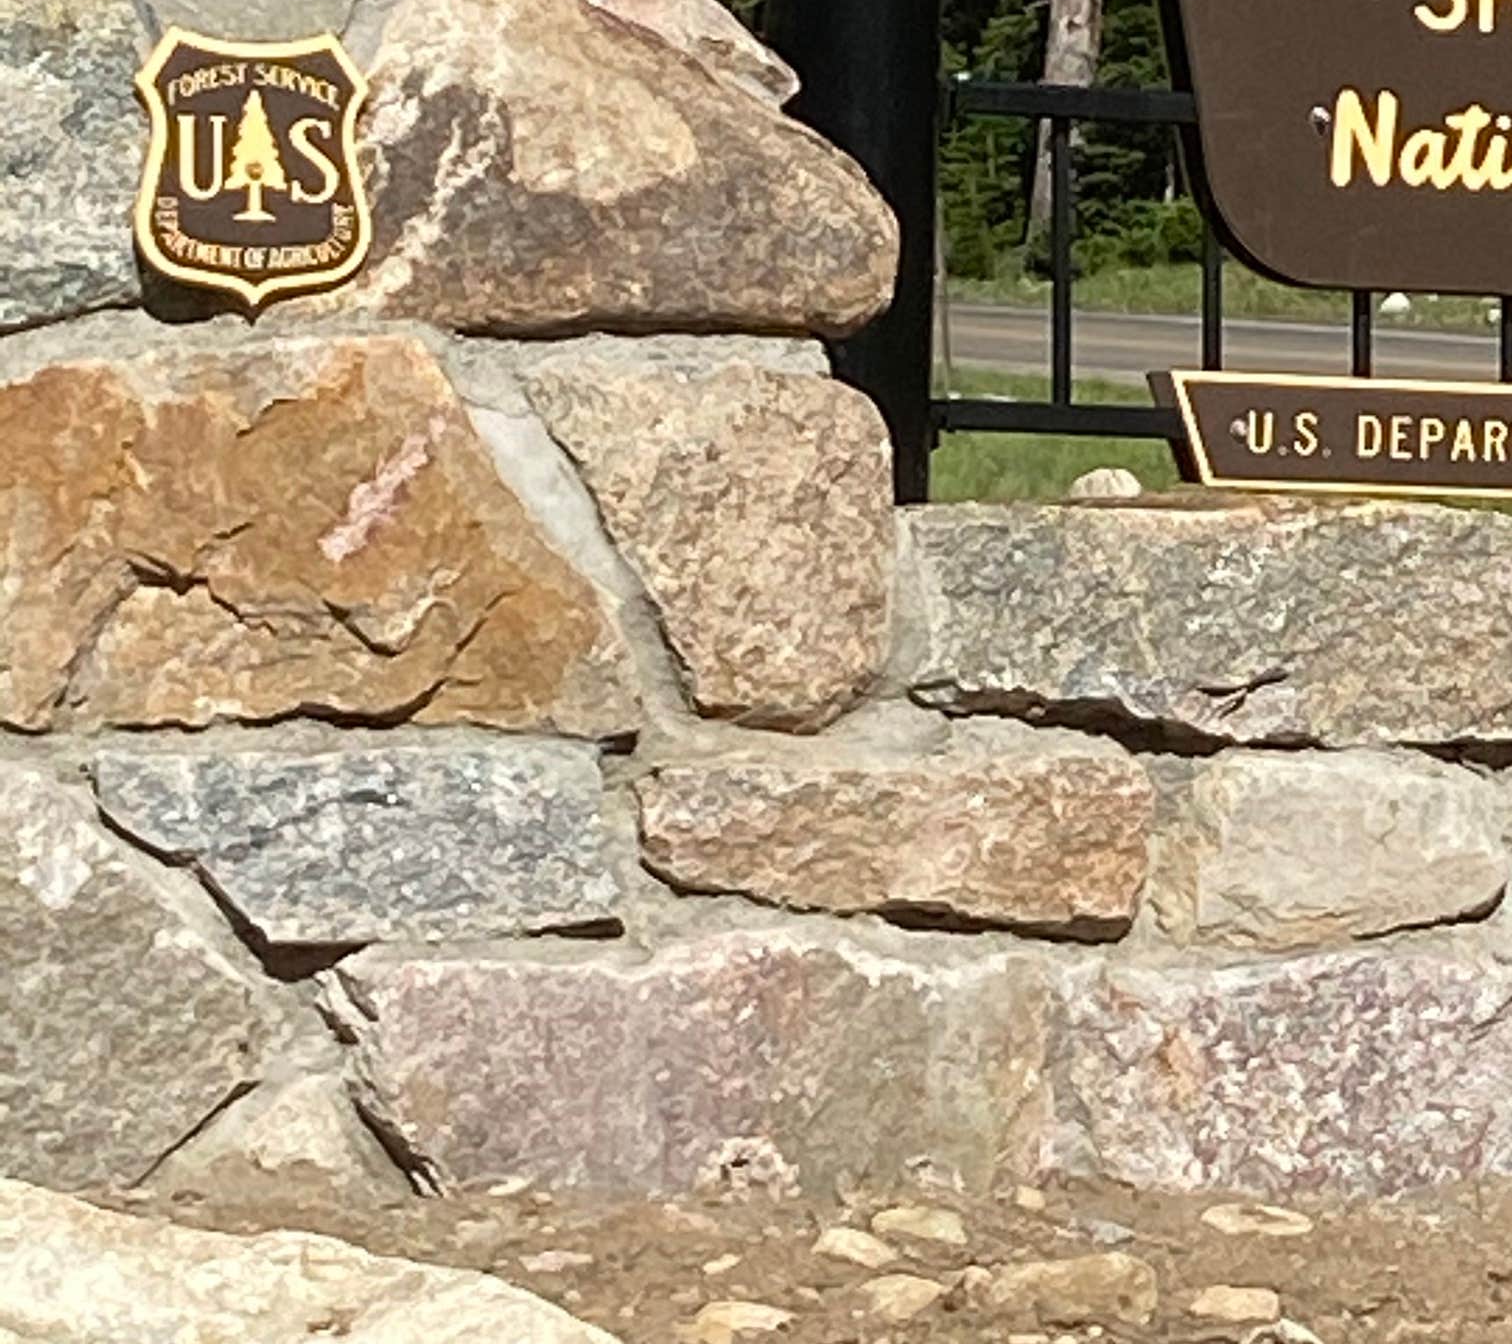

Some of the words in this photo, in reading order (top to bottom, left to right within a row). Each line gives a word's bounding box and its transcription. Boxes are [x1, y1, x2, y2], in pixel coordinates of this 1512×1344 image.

[167, 62, 248, 106] FOREST
[251, 62, 340, 111] SERVICE
[244, 246, 268, 269] OF
[1246, 409, 1331, 457] U.S.
